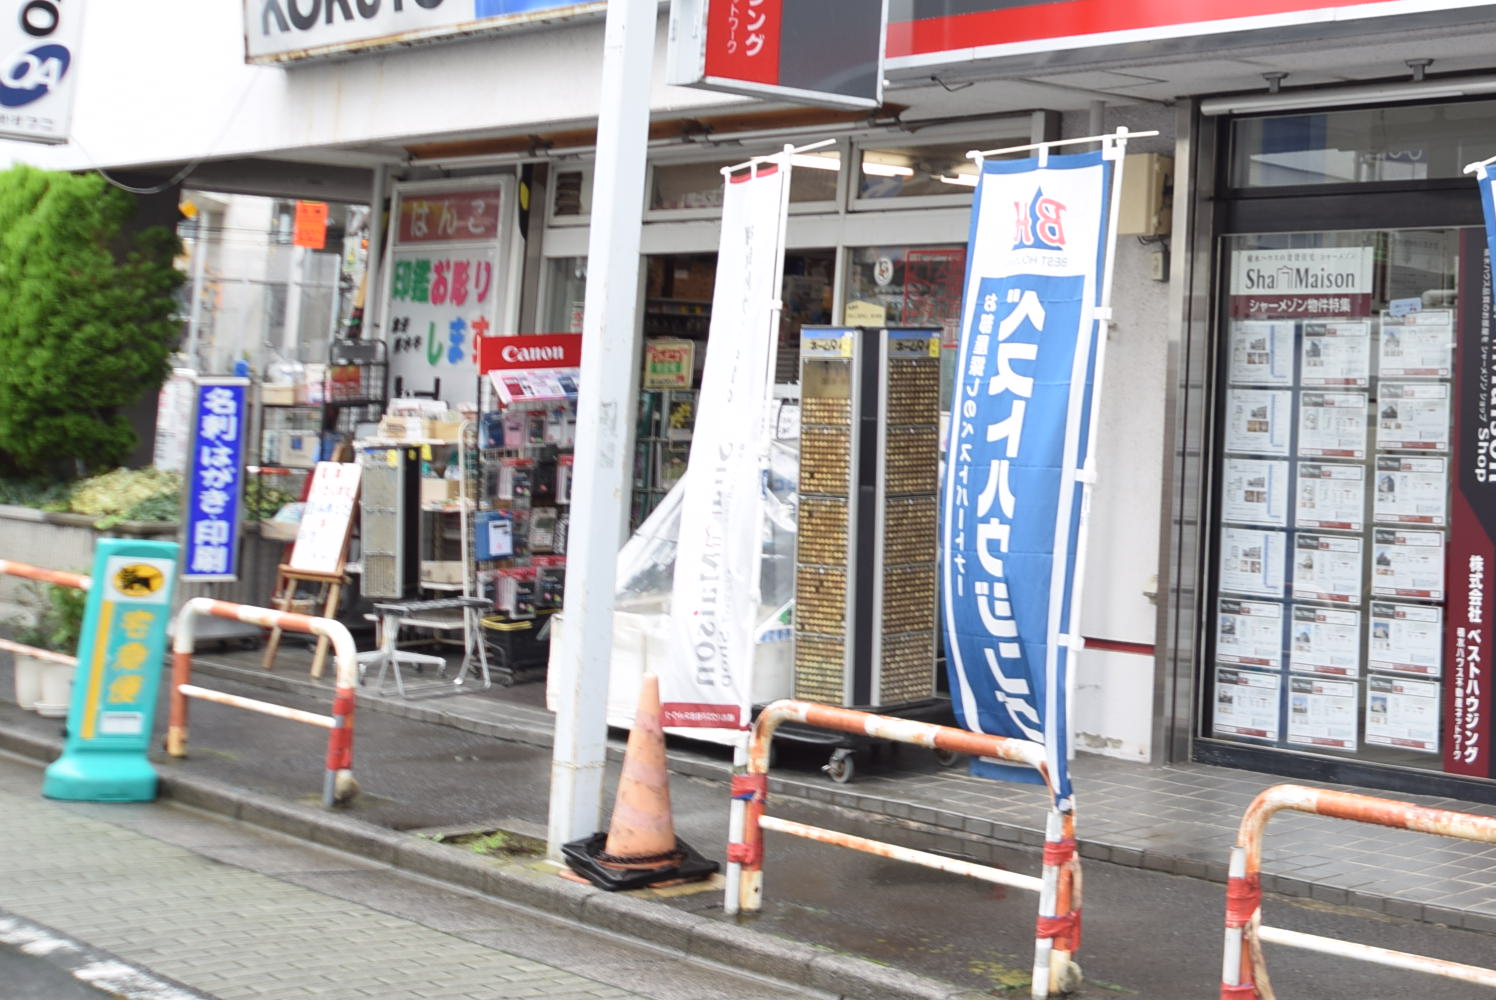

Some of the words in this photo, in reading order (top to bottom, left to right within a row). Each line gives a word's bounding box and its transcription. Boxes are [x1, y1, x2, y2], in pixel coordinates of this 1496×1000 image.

[411, 201, 486, 238] はんこ
[1245, 268, 1276, 289] Sha
[1294, 267, 1356, 289] Maison
[501, 344, 564, 363] Canon
[1475, 427, 1489, 483] Shop
[1467, 554, 1485, 623] 株式会社
[1463, 628, 1482, 764] ベストハウジング
